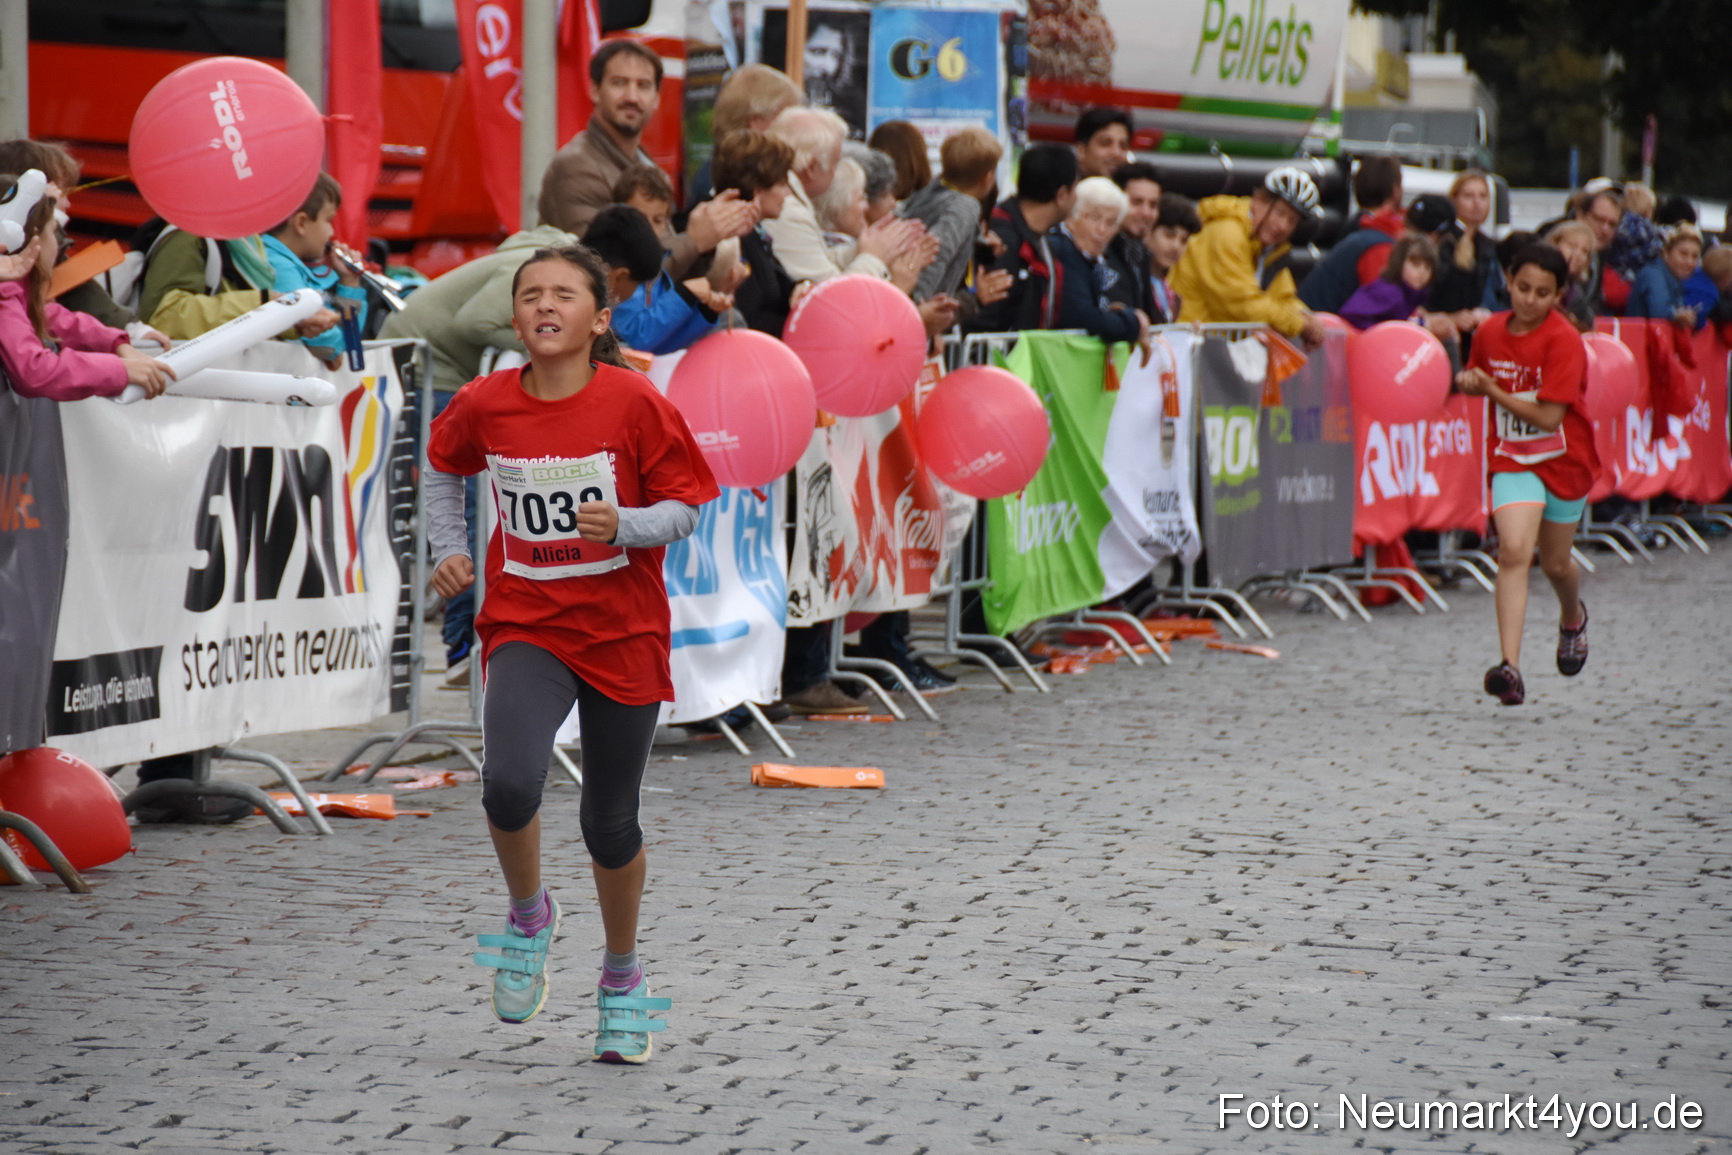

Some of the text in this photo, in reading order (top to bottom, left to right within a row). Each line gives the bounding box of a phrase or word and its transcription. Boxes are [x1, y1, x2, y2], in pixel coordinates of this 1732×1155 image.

[1191, 0, 1312, 86] Pellets
[531, 460, 600, 482] BOCK
[532, 545, 582, 563] Alicia
